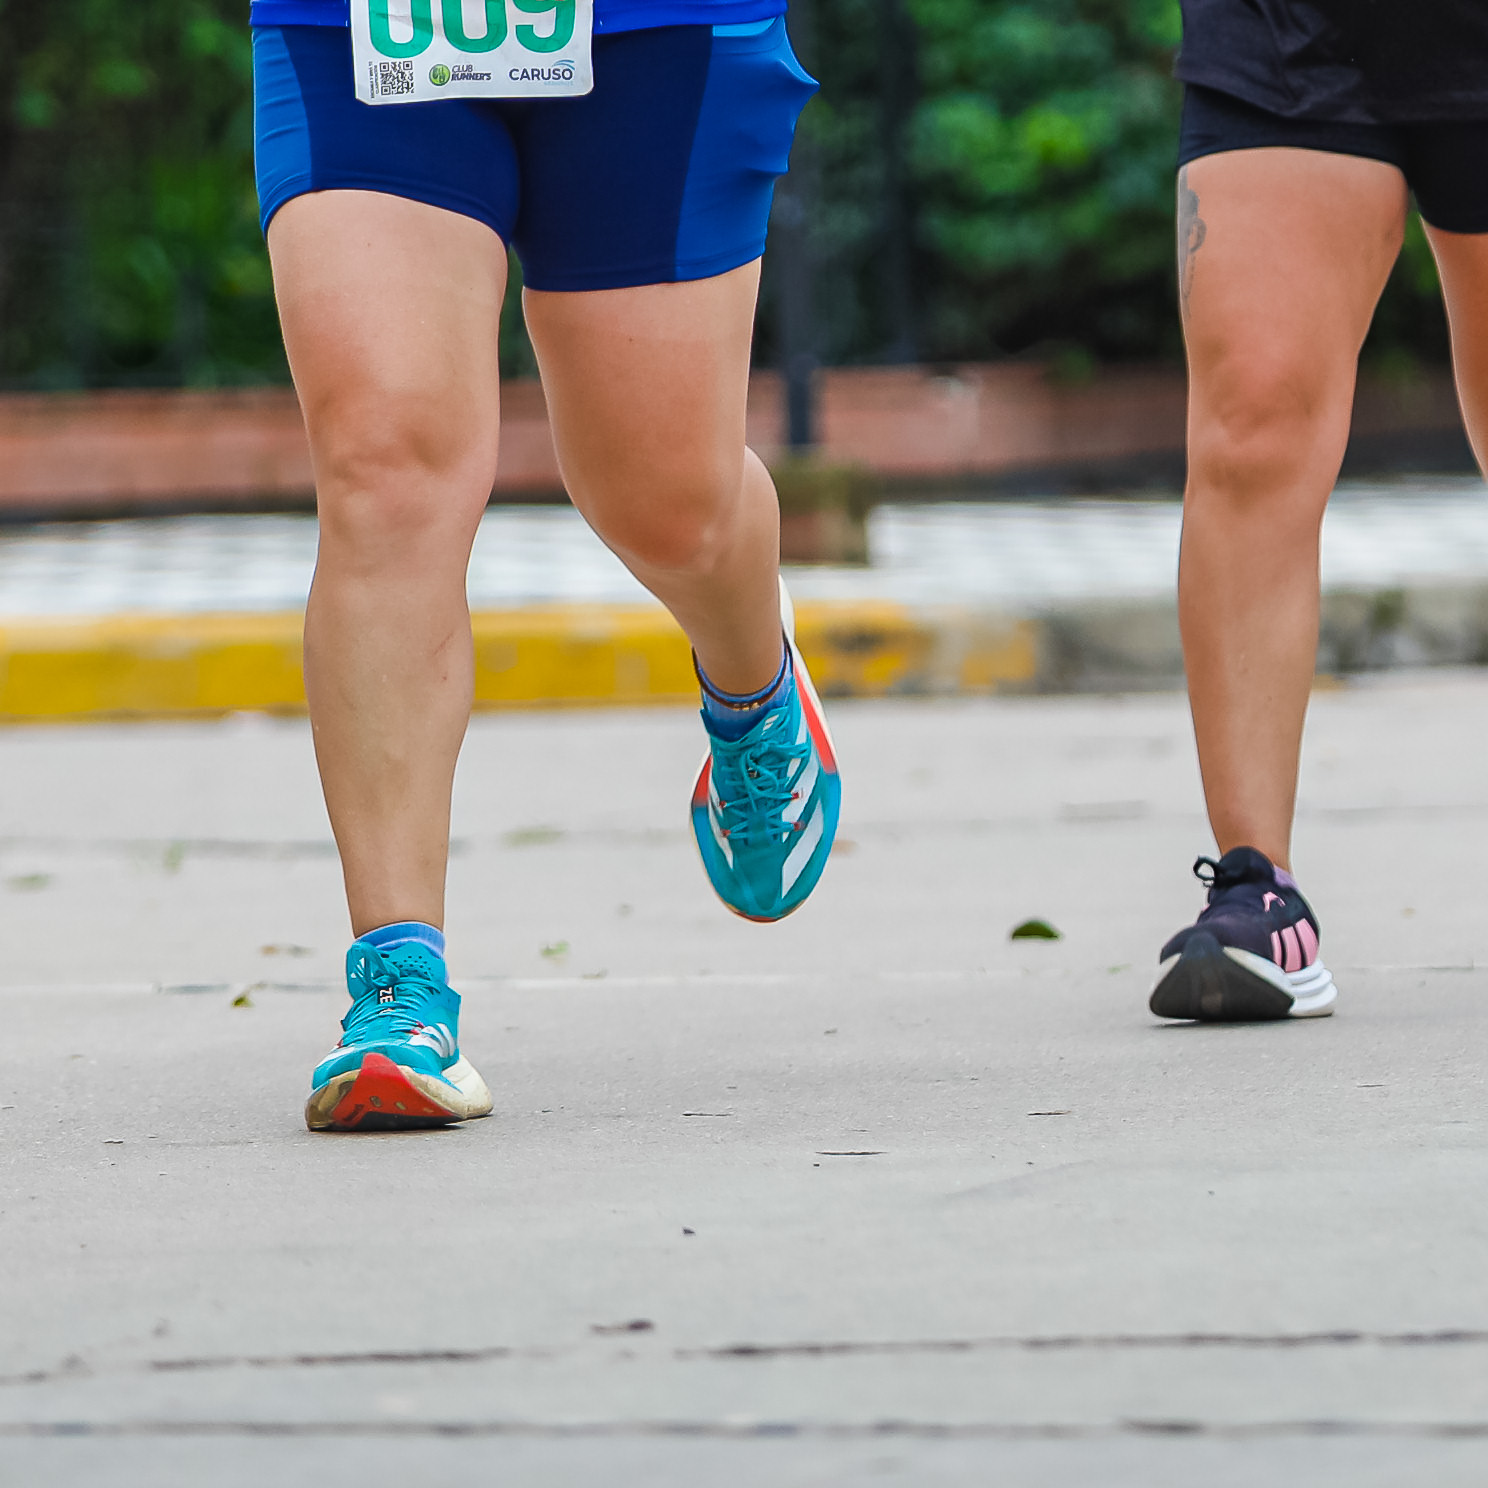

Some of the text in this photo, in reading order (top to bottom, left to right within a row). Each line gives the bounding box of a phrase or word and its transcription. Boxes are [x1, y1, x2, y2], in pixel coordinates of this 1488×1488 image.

[451, 64, 474, 72] CLUB
[450, 72, 492, 81] RUNNER'S
[508, 68, 574, 81] CARUSO
